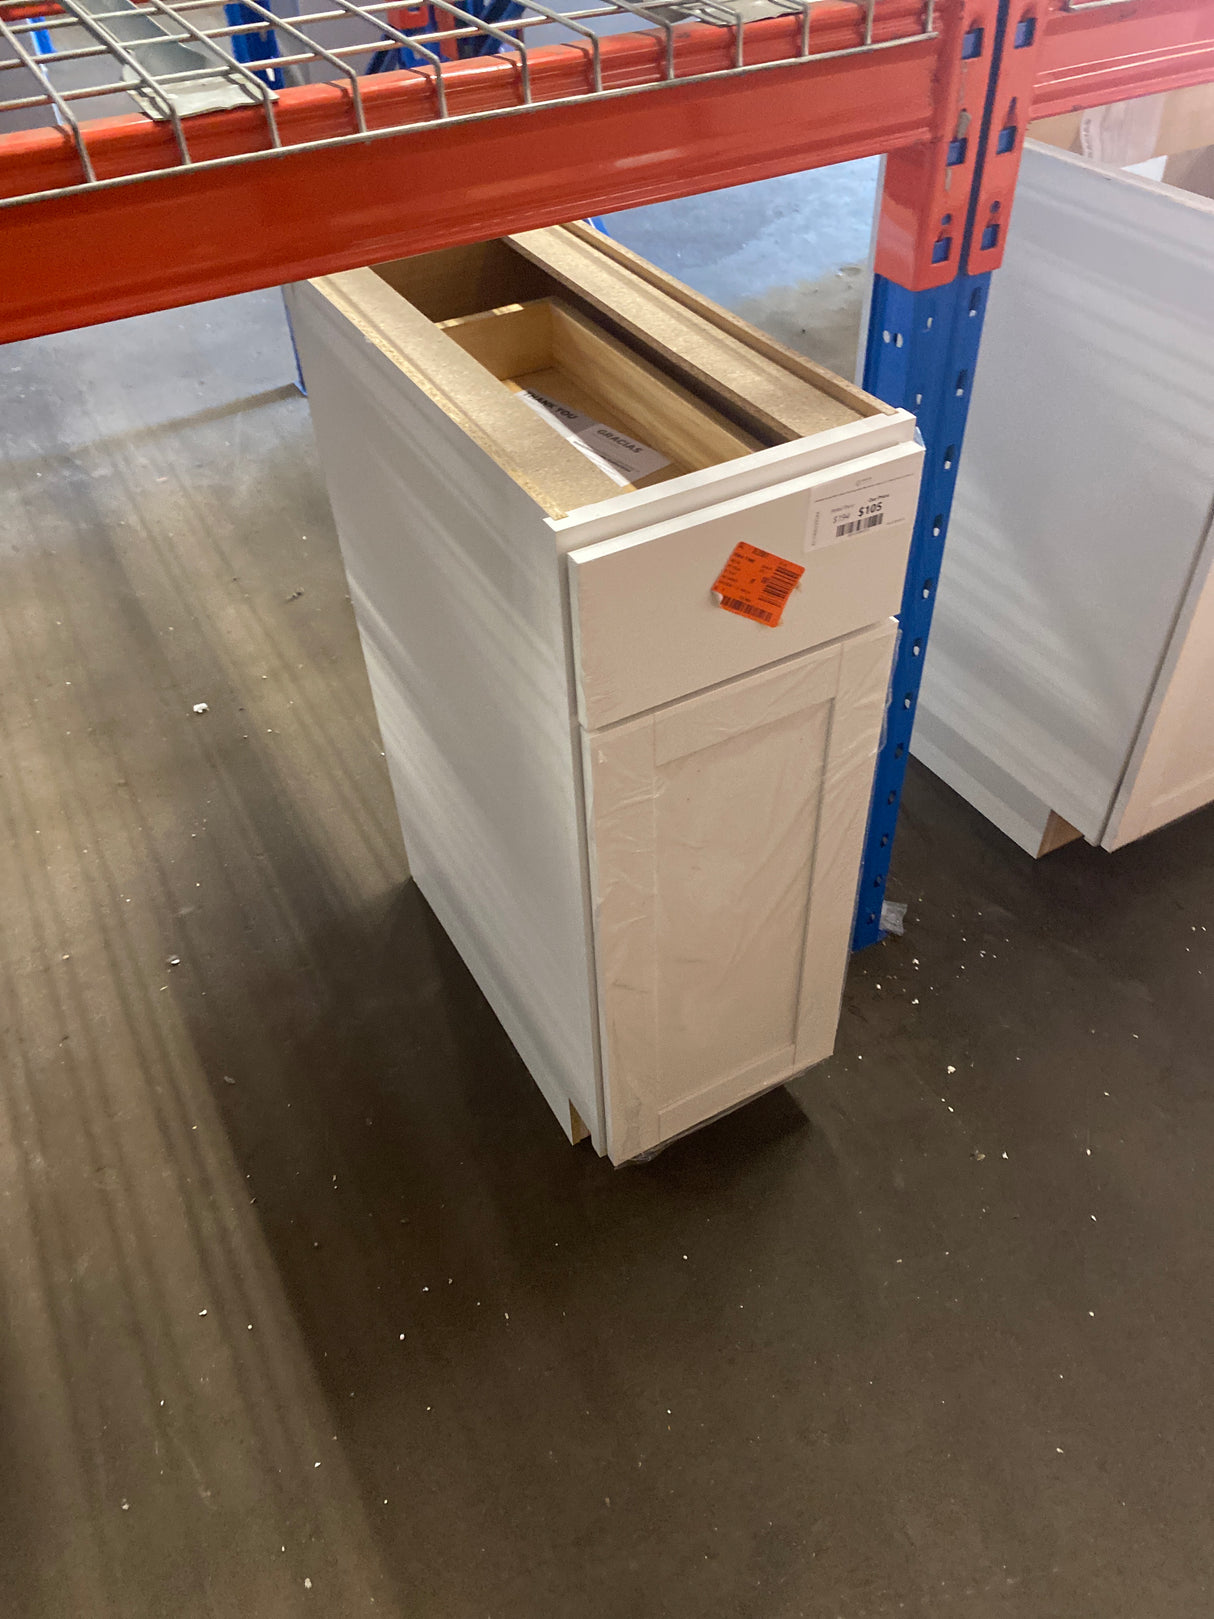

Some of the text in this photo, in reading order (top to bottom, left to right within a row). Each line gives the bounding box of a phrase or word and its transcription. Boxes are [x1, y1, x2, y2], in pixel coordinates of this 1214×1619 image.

[556, 407, 579, 420] YOU
[597, 428, 643, 454] GRACIAS
[858, 501, 883, 517] $105
